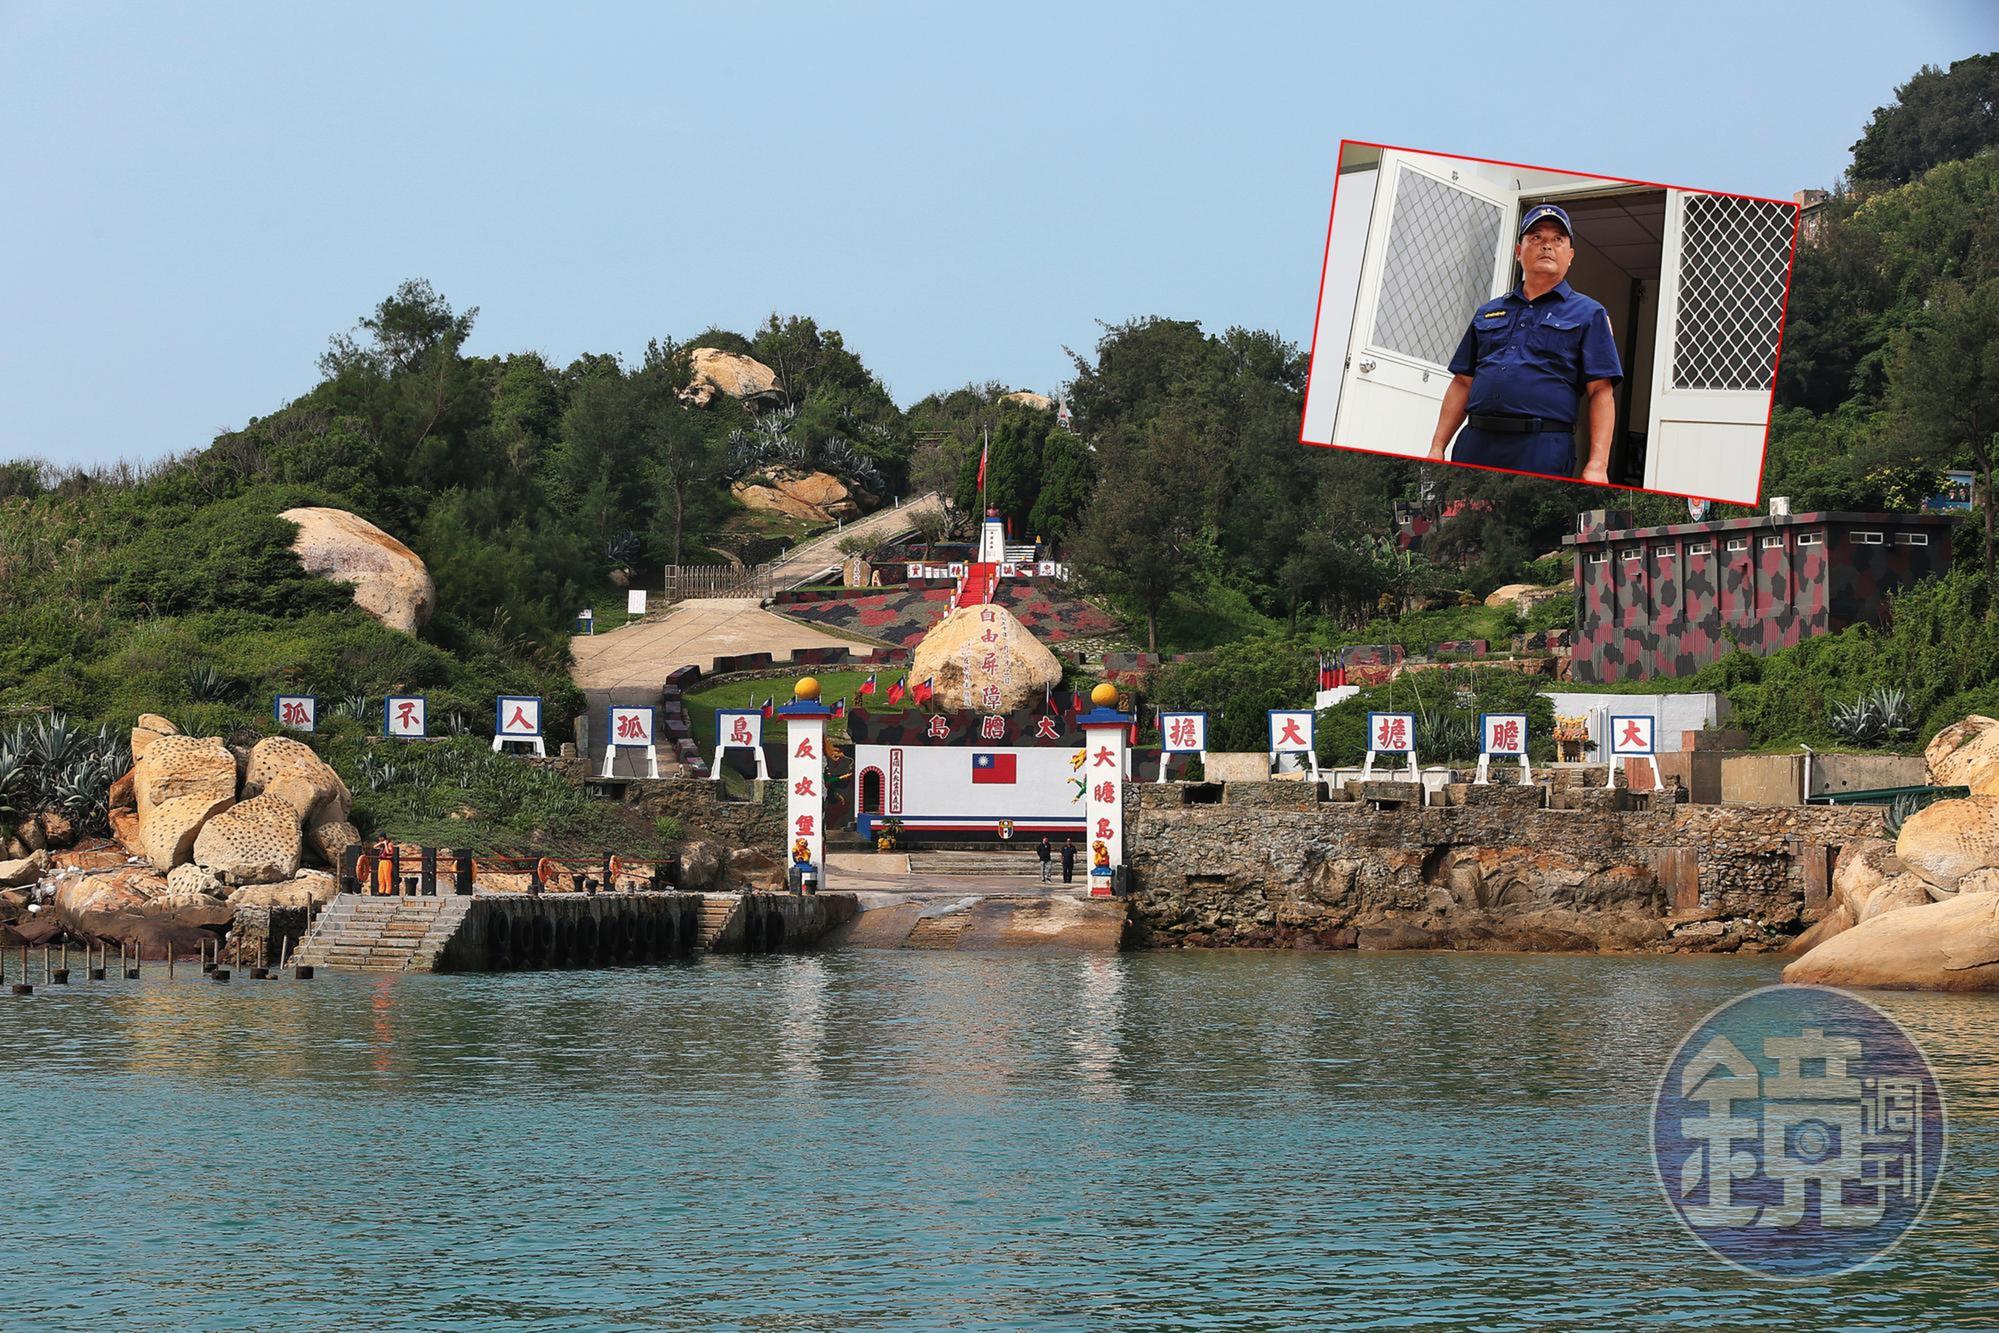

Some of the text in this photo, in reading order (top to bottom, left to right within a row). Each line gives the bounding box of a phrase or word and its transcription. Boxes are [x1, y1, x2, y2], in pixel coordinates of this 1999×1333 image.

[980, 608, 1002, 711] 自由屏障
[282, 702, 312, 725] 孤
[398, 702, 422, 727] 不
[505, 705, 536, 730] 人
[617, 714, 648, 740] 孤
[729, 716, 753, 747] 島
[1277, 717, 1307, 746] 大
[1492, 719, 1520, 752] 膽
[1619, 720, 1648, 748] 大
[794, 737, 817, 837] 反攻堡
[1093, 745, 1116, 841] 大膽島
